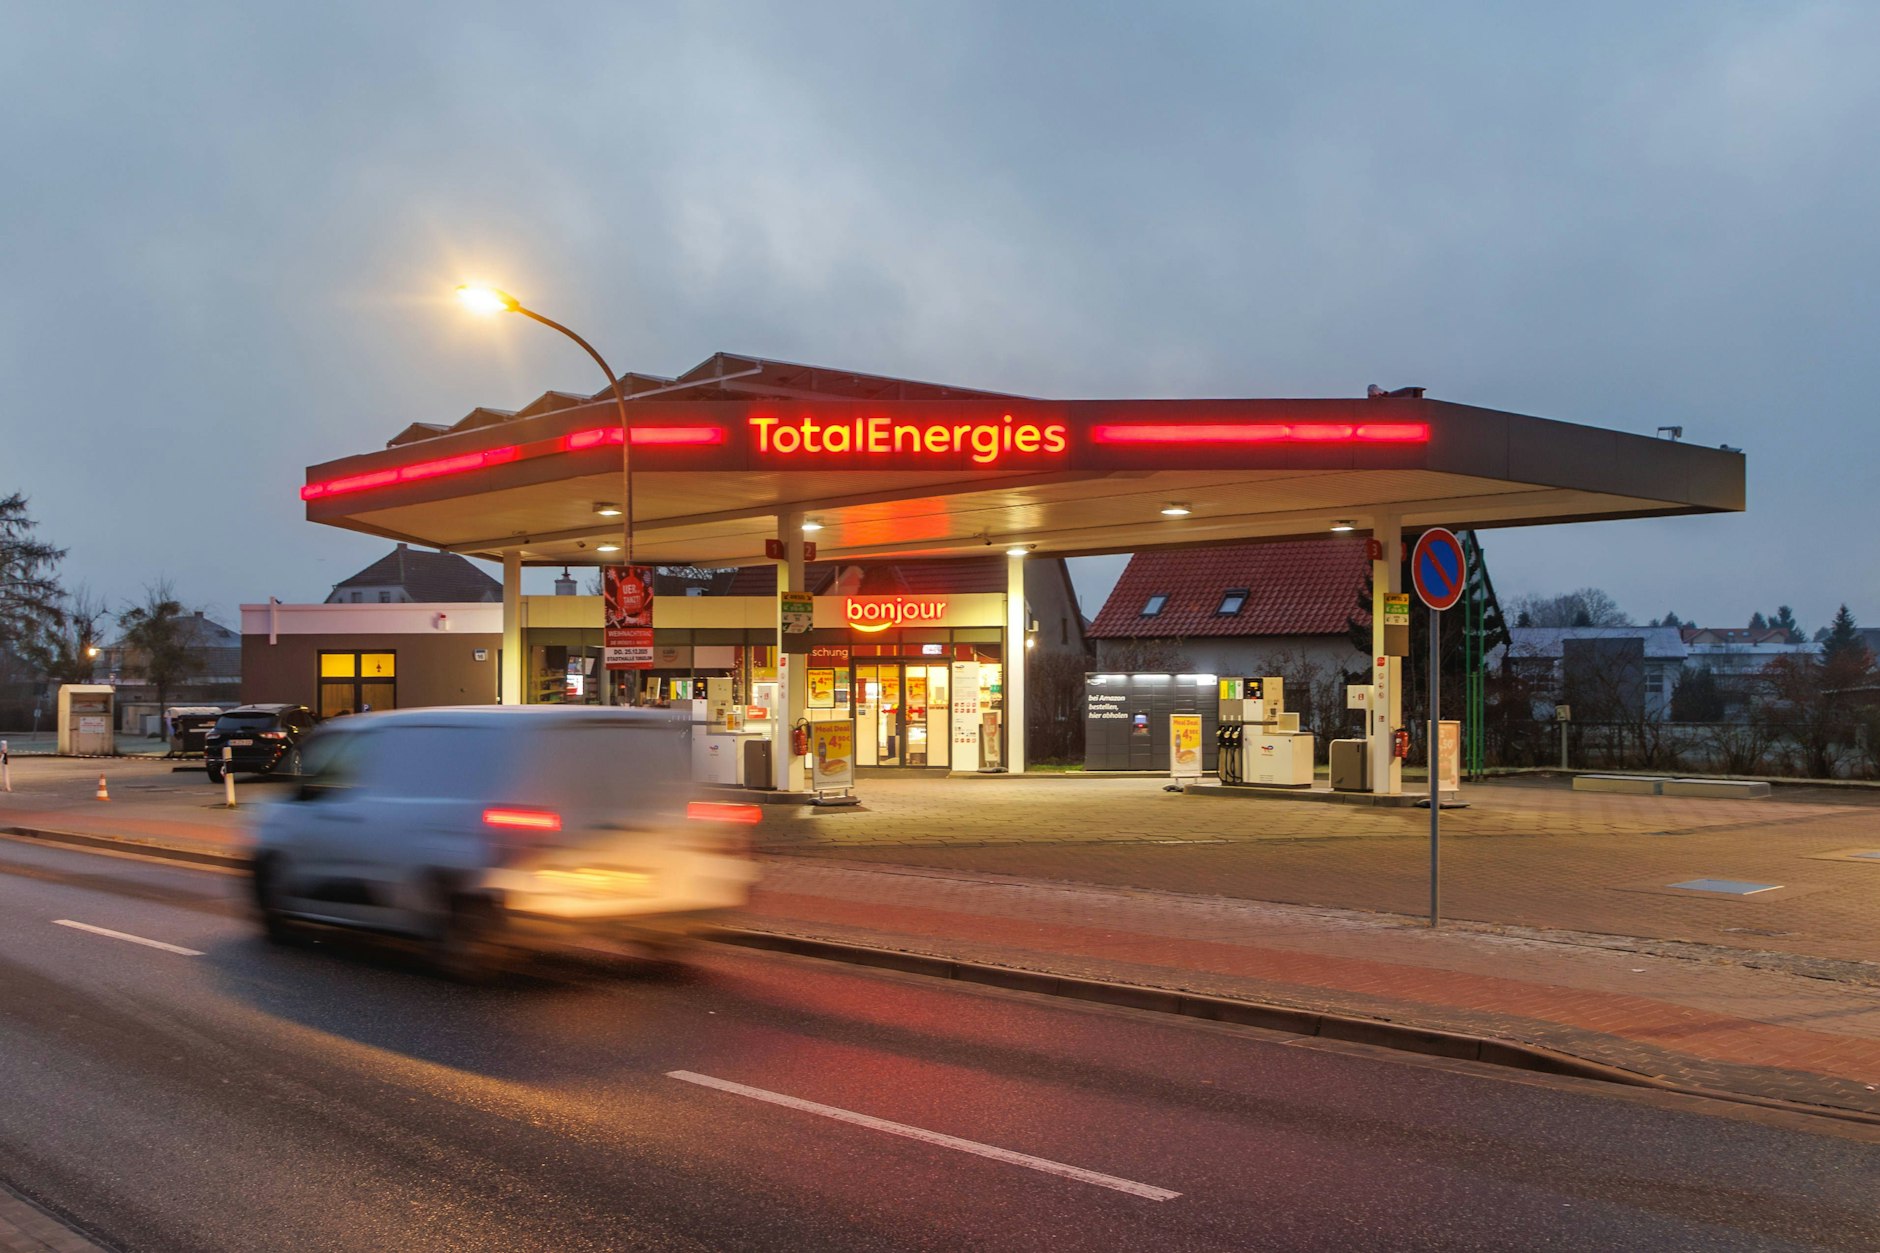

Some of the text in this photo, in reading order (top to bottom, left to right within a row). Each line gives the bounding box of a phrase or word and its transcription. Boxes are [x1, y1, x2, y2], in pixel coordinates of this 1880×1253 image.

[749, 414, 1066, 463] TotalEnergies
[772, 544, 778, 554] 1
[805, 546, 812, 557] 2
[1372, 544, 1378, 555] 3
[846, 597, 946, 624] bonjour
[811, 647, 849, 660] schung
